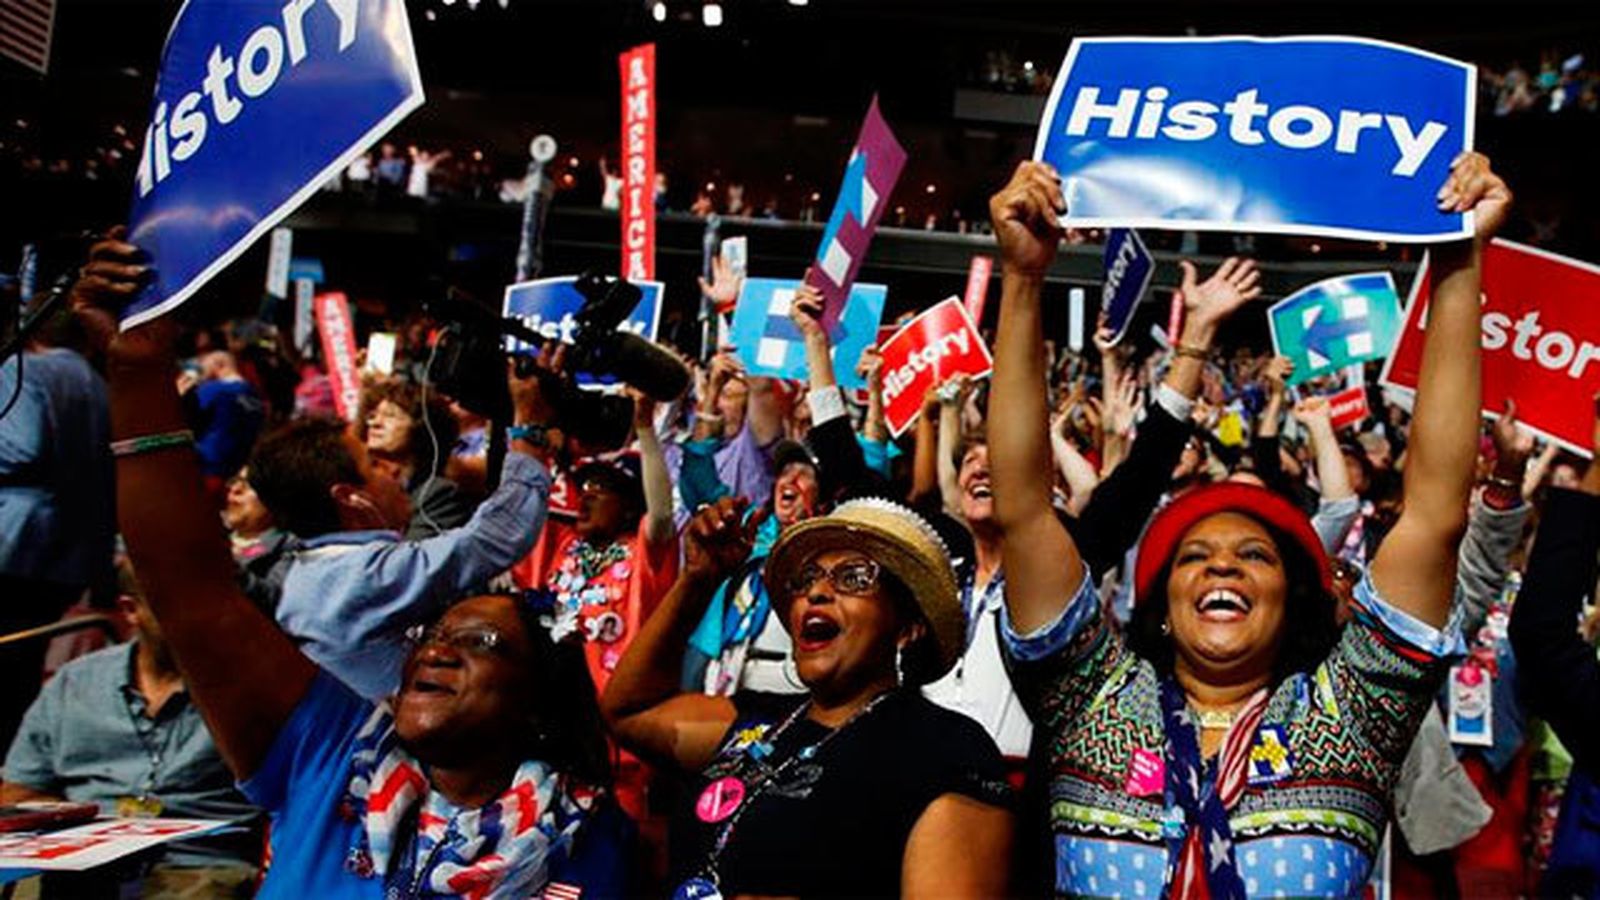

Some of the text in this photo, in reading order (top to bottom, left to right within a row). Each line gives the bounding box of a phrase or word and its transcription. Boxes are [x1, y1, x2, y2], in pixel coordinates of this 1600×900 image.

[134, 0, 358, 198] istory
[627, 56, 648, 280] AMERICA
[1066, 87, 1448, 178] History
[1417, 293, 1600, 379] stor
